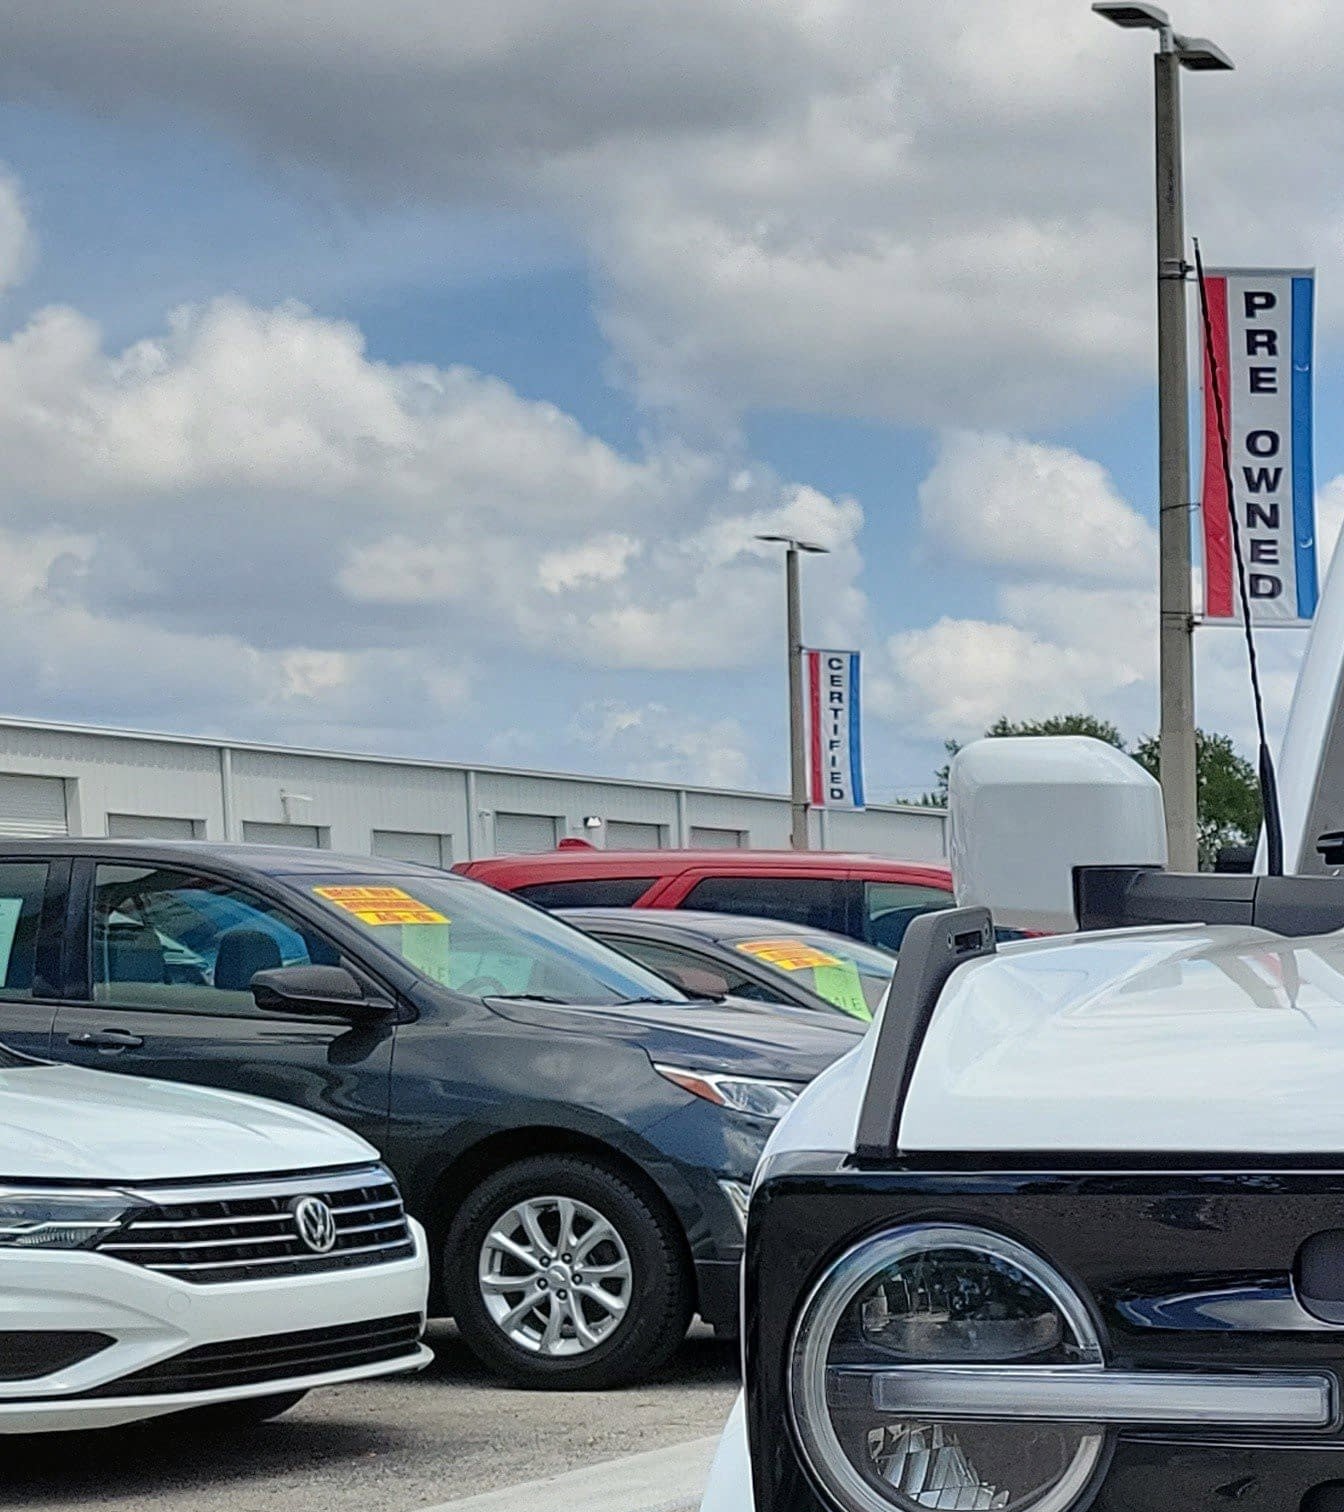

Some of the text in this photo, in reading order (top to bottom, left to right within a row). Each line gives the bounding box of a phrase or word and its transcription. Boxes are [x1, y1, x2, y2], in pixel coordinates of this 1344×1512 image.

[1243, 291, 1283, 600] PRE OWNED
[828, 657, 843, 800] CERTIFIED
